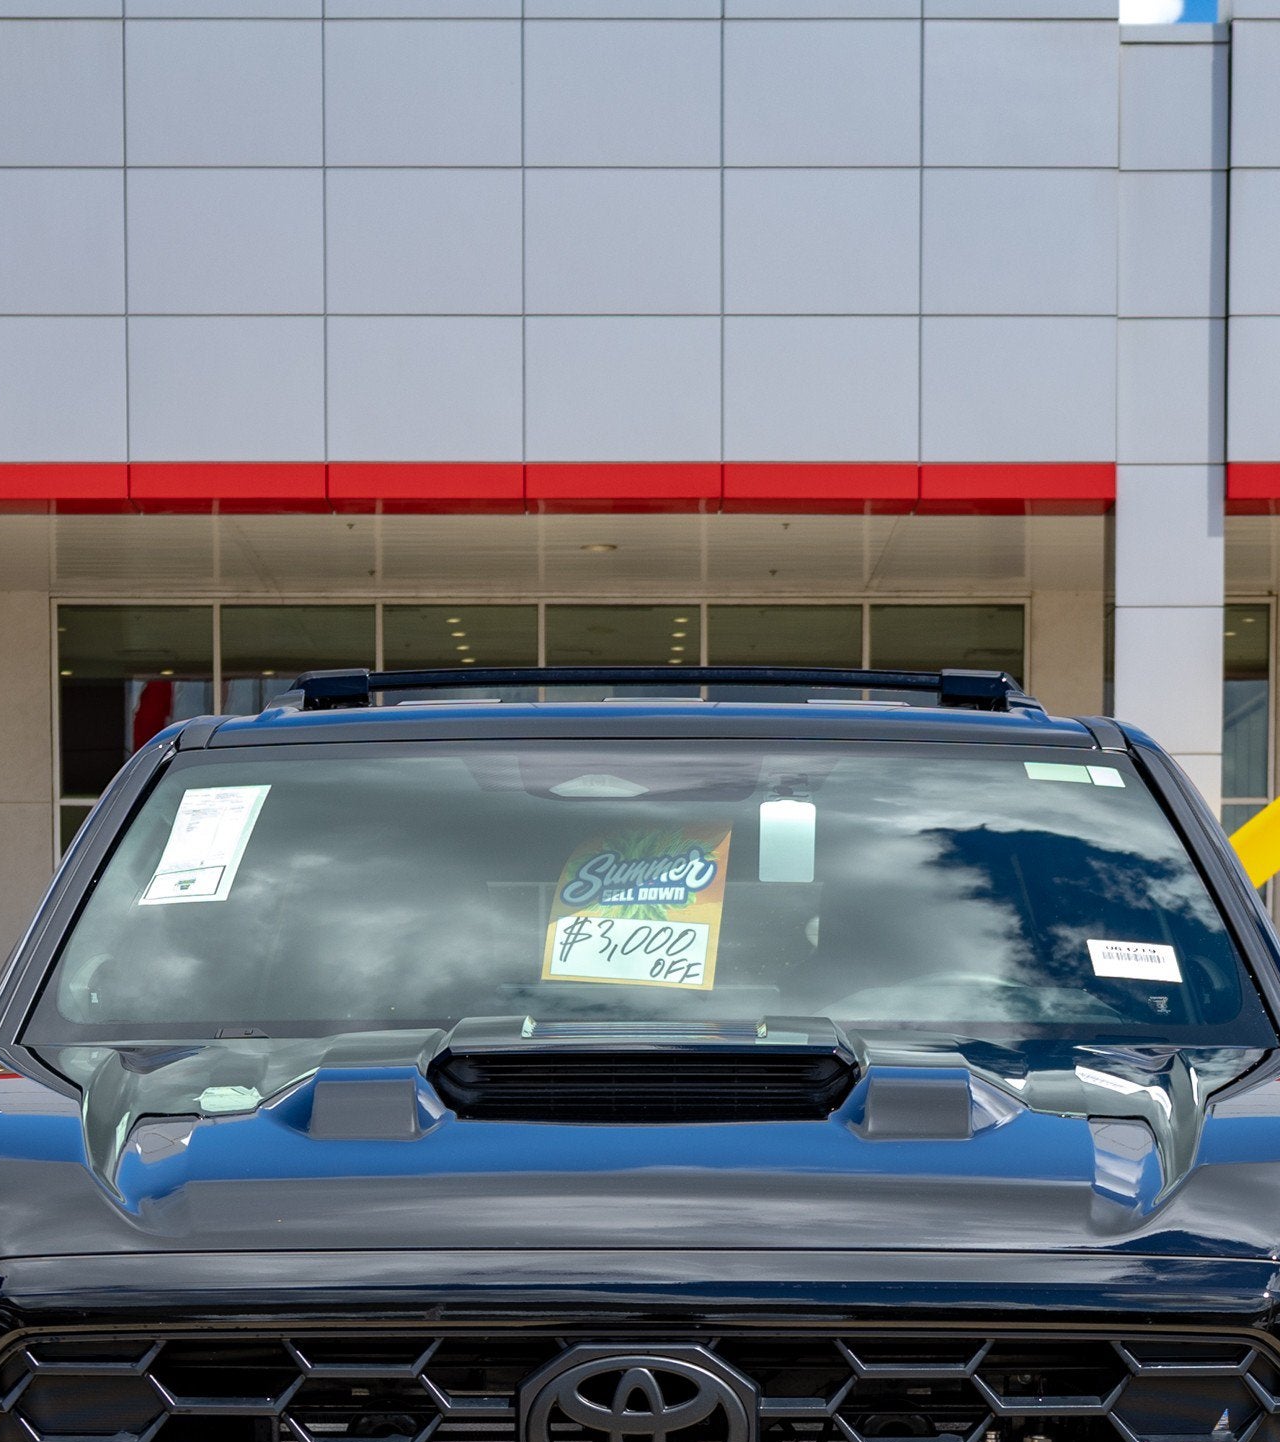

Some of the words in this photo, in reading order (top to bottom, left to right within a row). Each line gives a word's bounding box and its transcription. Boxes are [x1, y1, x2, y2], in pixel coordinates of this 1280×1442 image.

[562, 849, 715, 904] Summer
[601, 887, 635, 902] SELL
[637, 886, 685, 901] DOWN
[559, 916, 697, 963] $3,000
[649, 958, 702, 984] OFF
